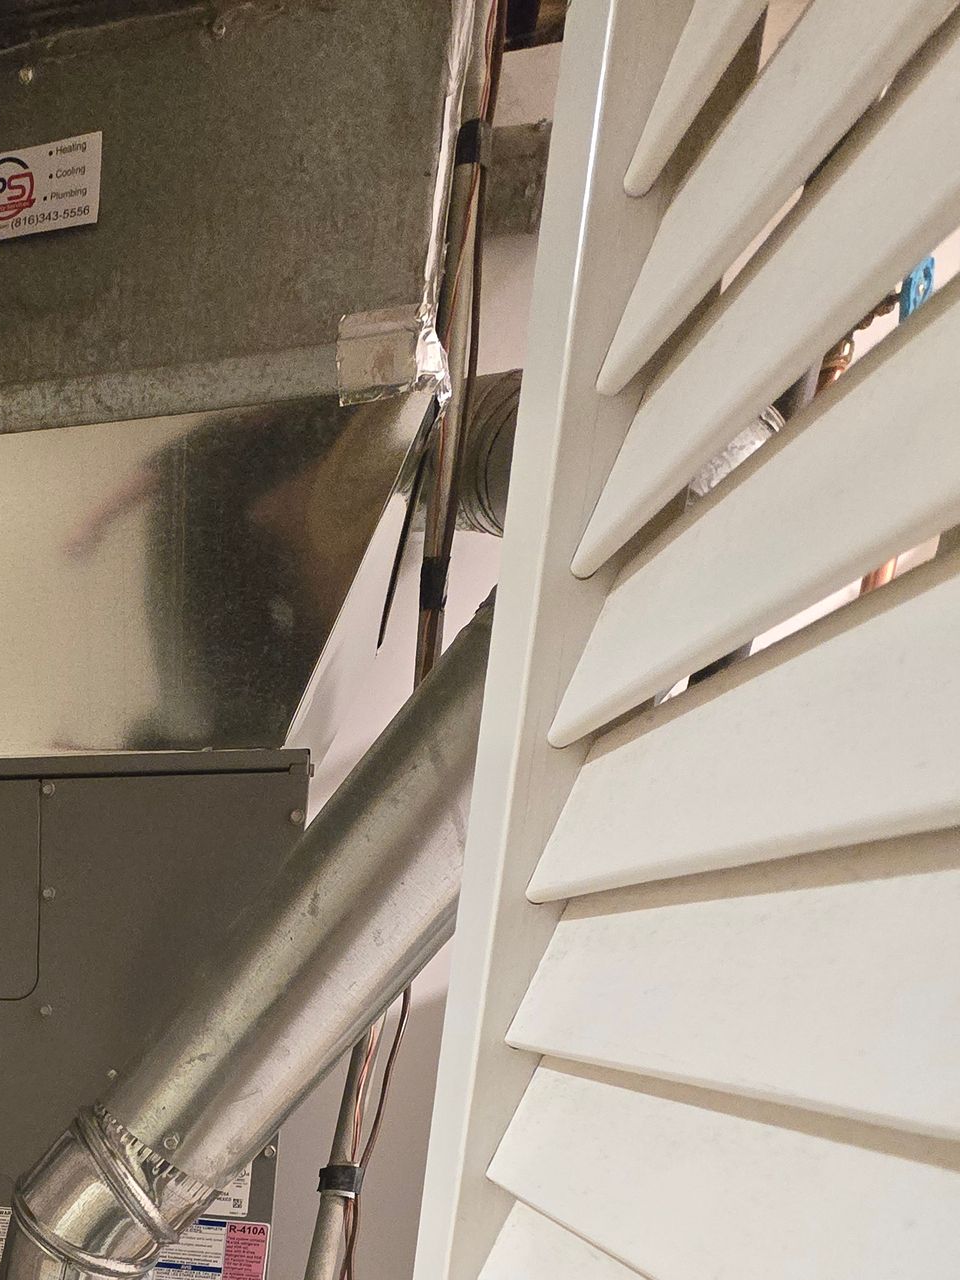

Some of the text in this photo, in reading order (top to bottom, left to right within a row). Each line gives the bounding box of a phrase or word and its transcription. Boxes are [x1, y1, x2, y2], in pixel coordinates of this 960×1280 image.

[55, 141, 87, 155] Heating
[55, 165, 86, 178] Cooling
[50, 187, 88, 201] Plumbing
[10, 206, 90, 230] (816)343-5556
[229, 1224, 266, 1236] R-410A
